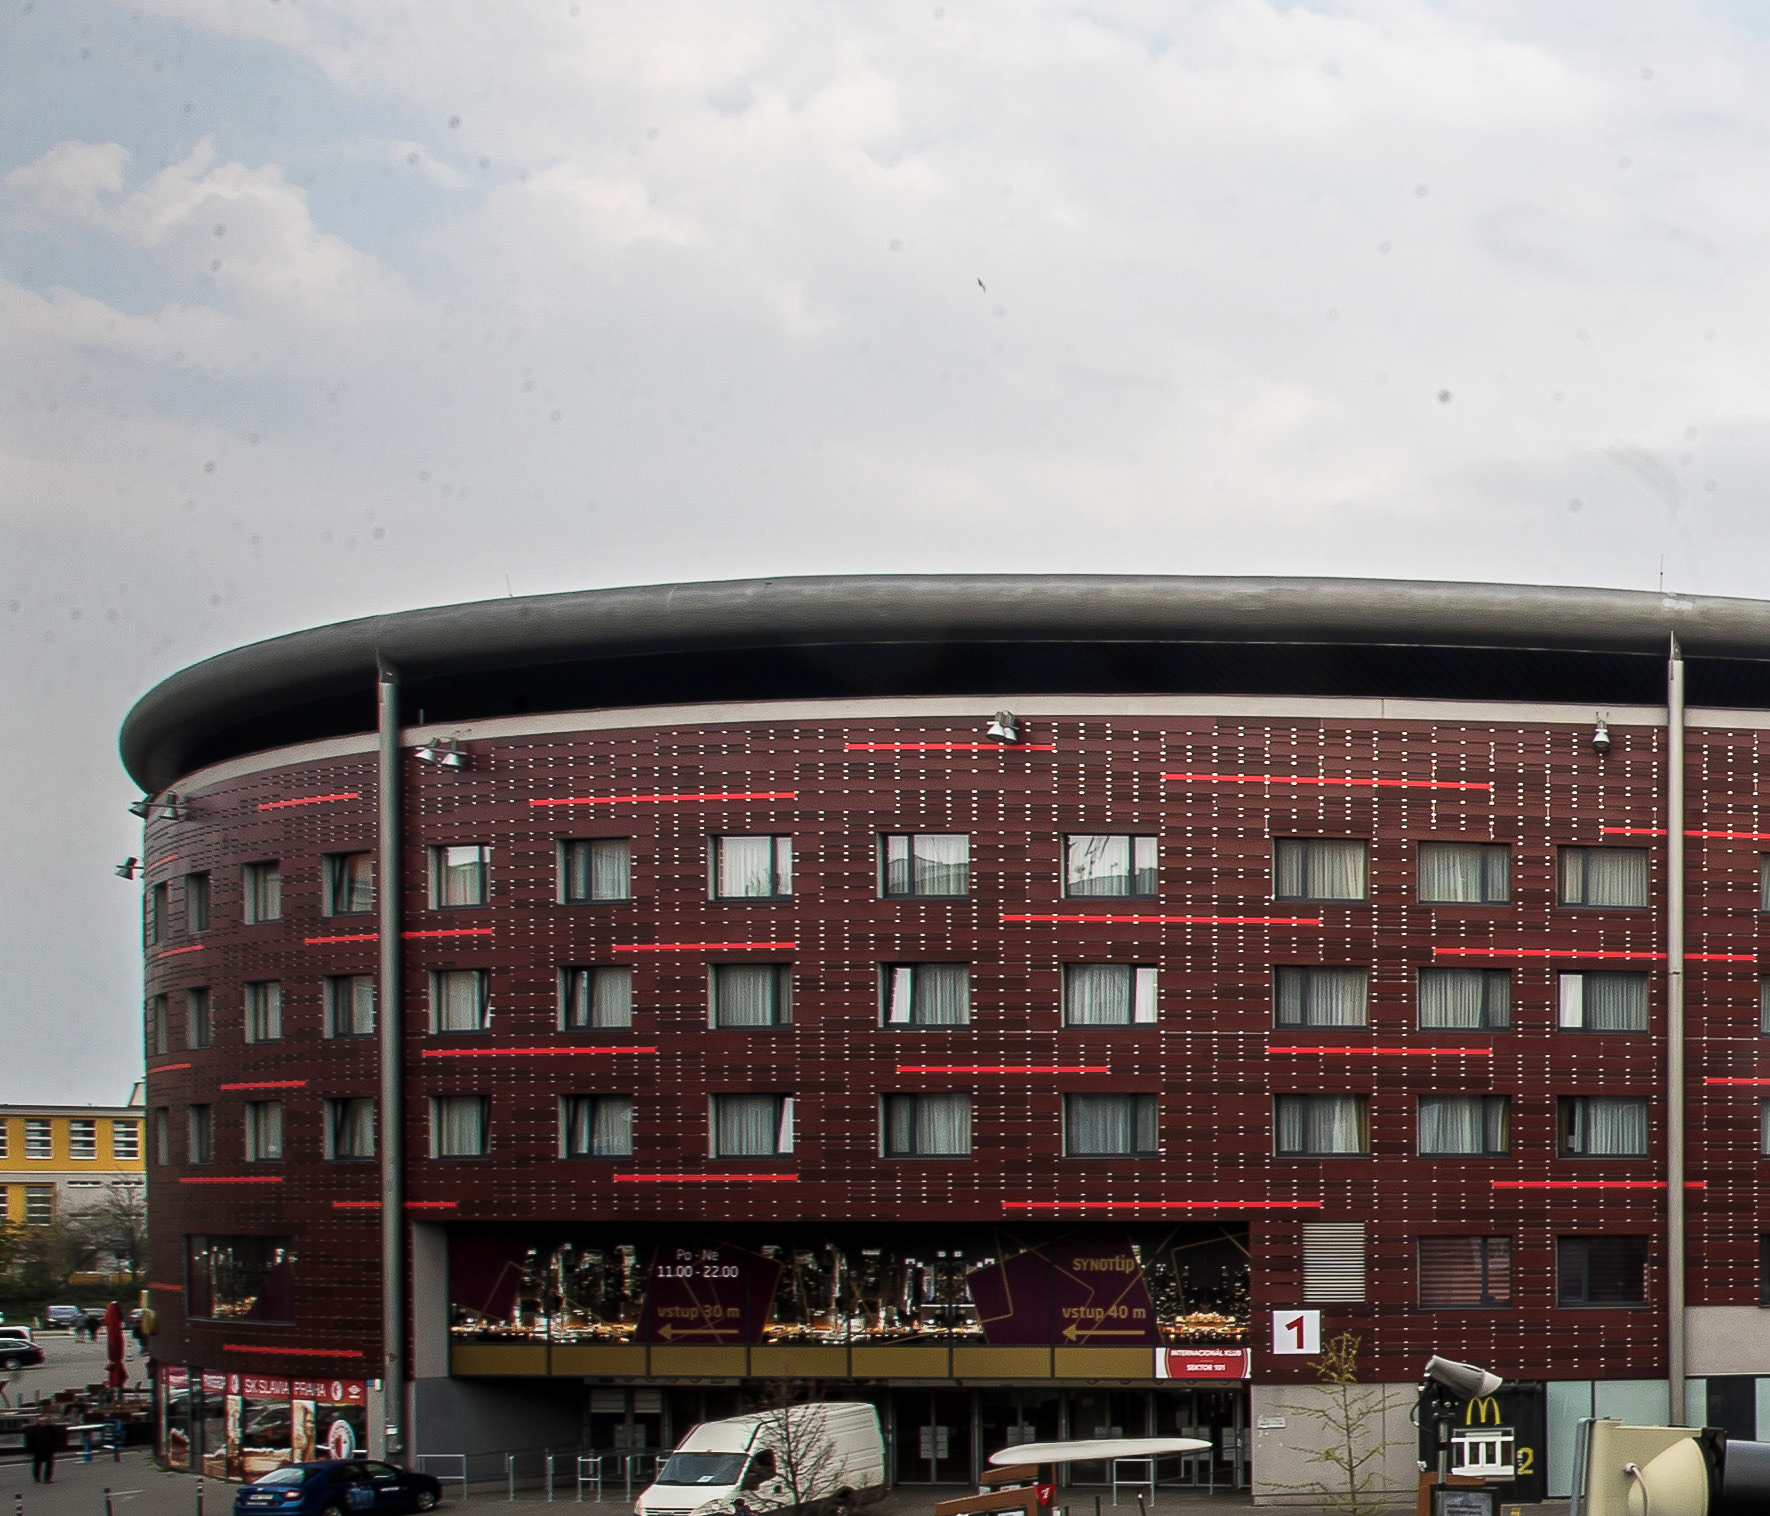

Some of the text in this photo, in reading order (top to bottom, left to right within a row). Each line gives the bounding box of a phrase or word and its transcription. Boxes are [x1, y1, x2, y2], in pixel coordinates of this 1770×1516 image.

[657, 1305, 739, 1320] vstup 30 m
[1062, 1305, 1146, 1321] vstup 40 m
[1285, 1315, 1304, 1349] 1
